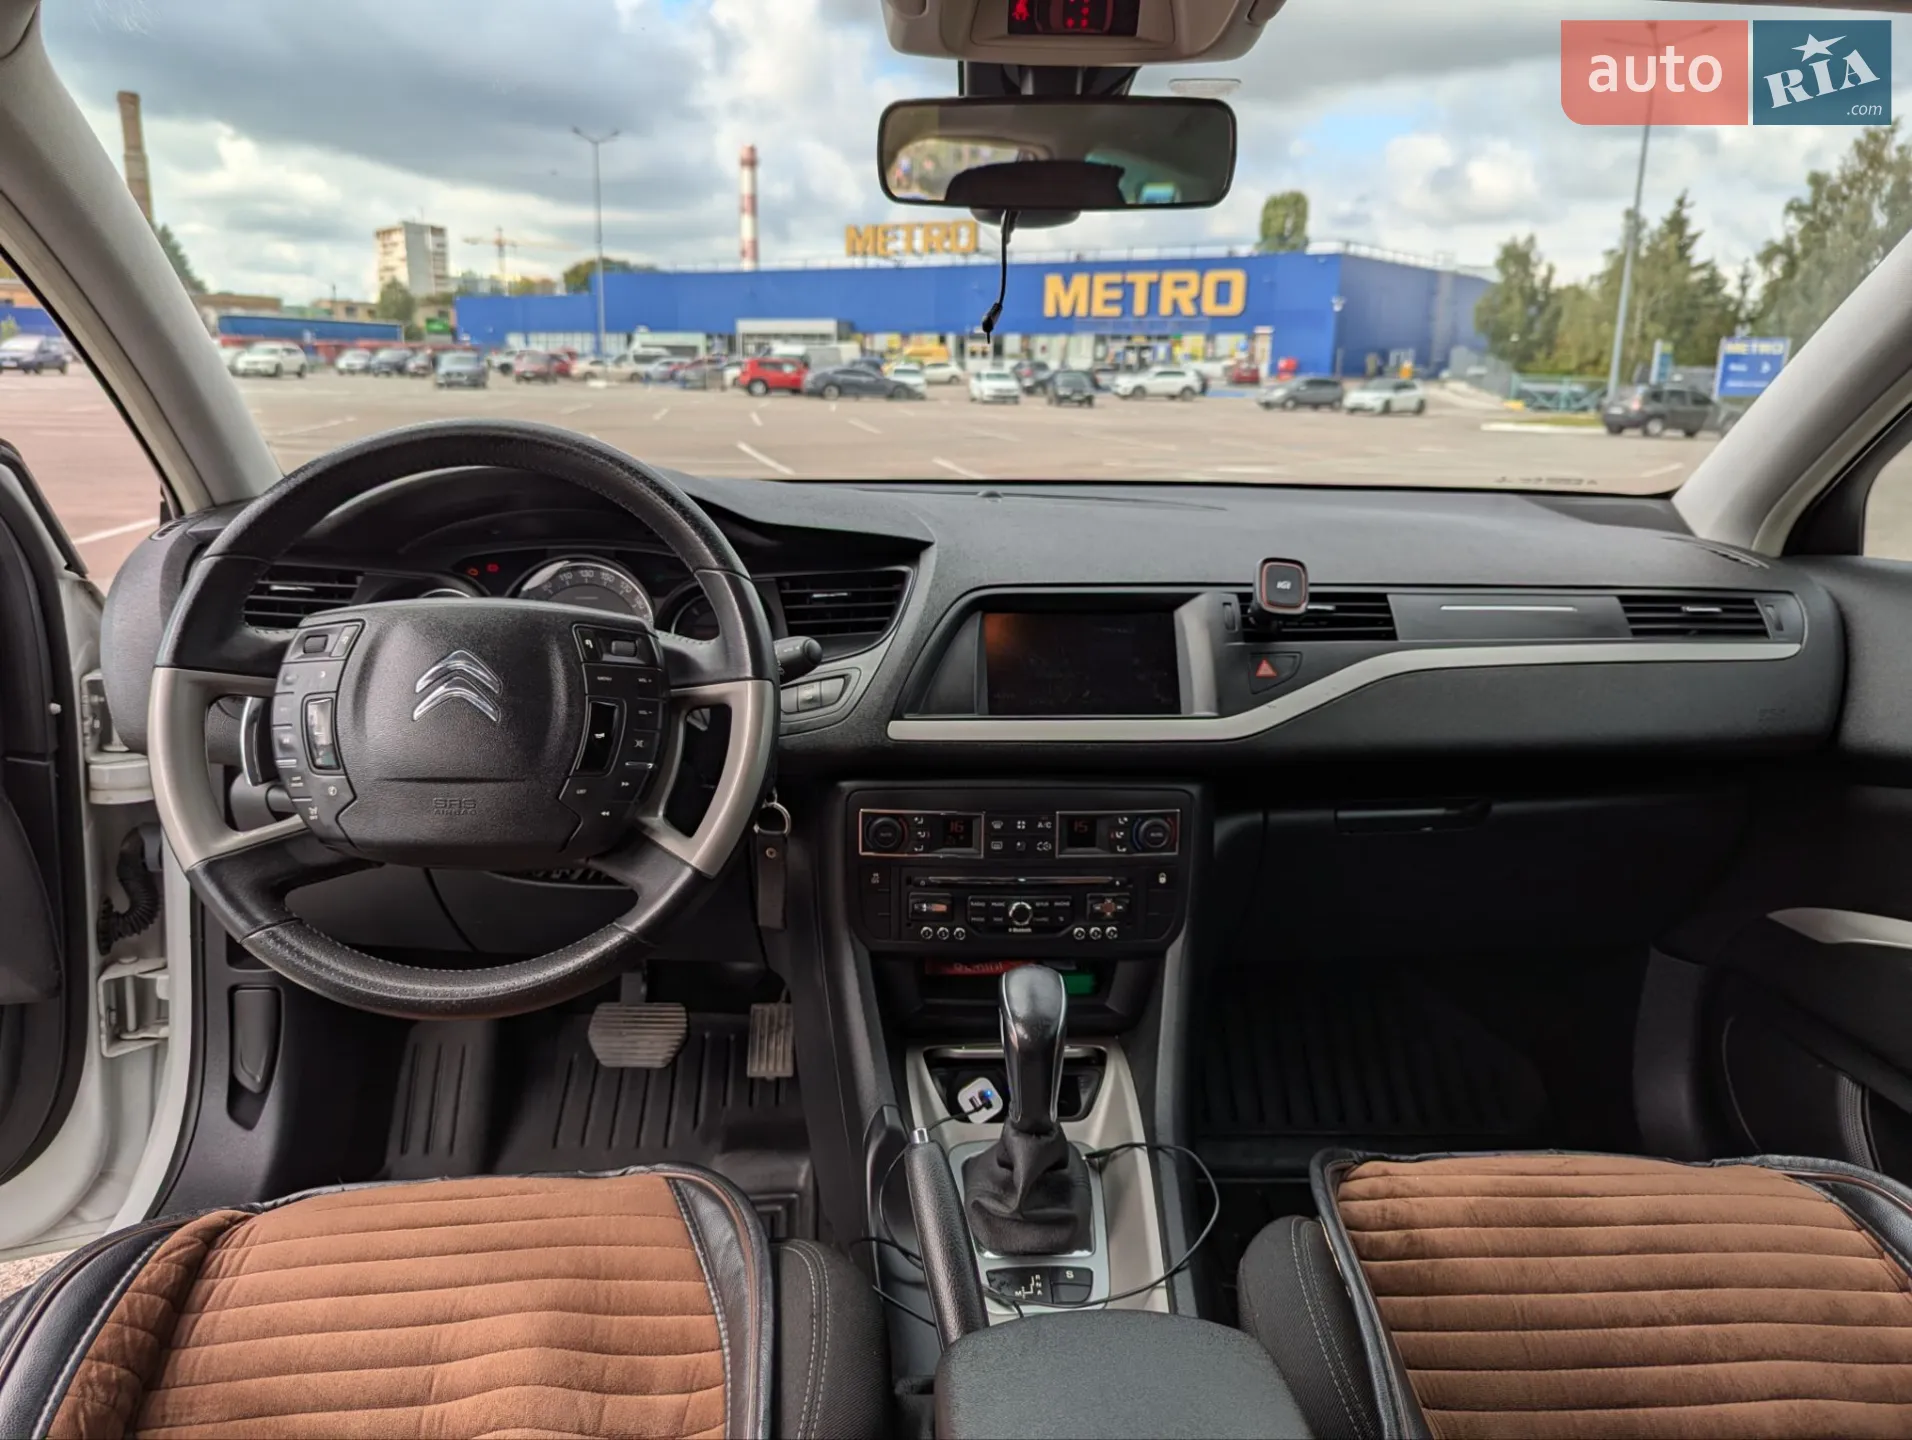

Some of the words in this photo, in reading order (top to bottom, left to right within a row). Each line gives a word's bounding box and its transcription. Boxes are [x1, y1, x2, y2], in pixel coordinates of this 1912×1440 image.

[845, 219, 978, 256] METRO
[1043, 269, 1247, 318] METRO
[949, 820, 964, 833] 16
